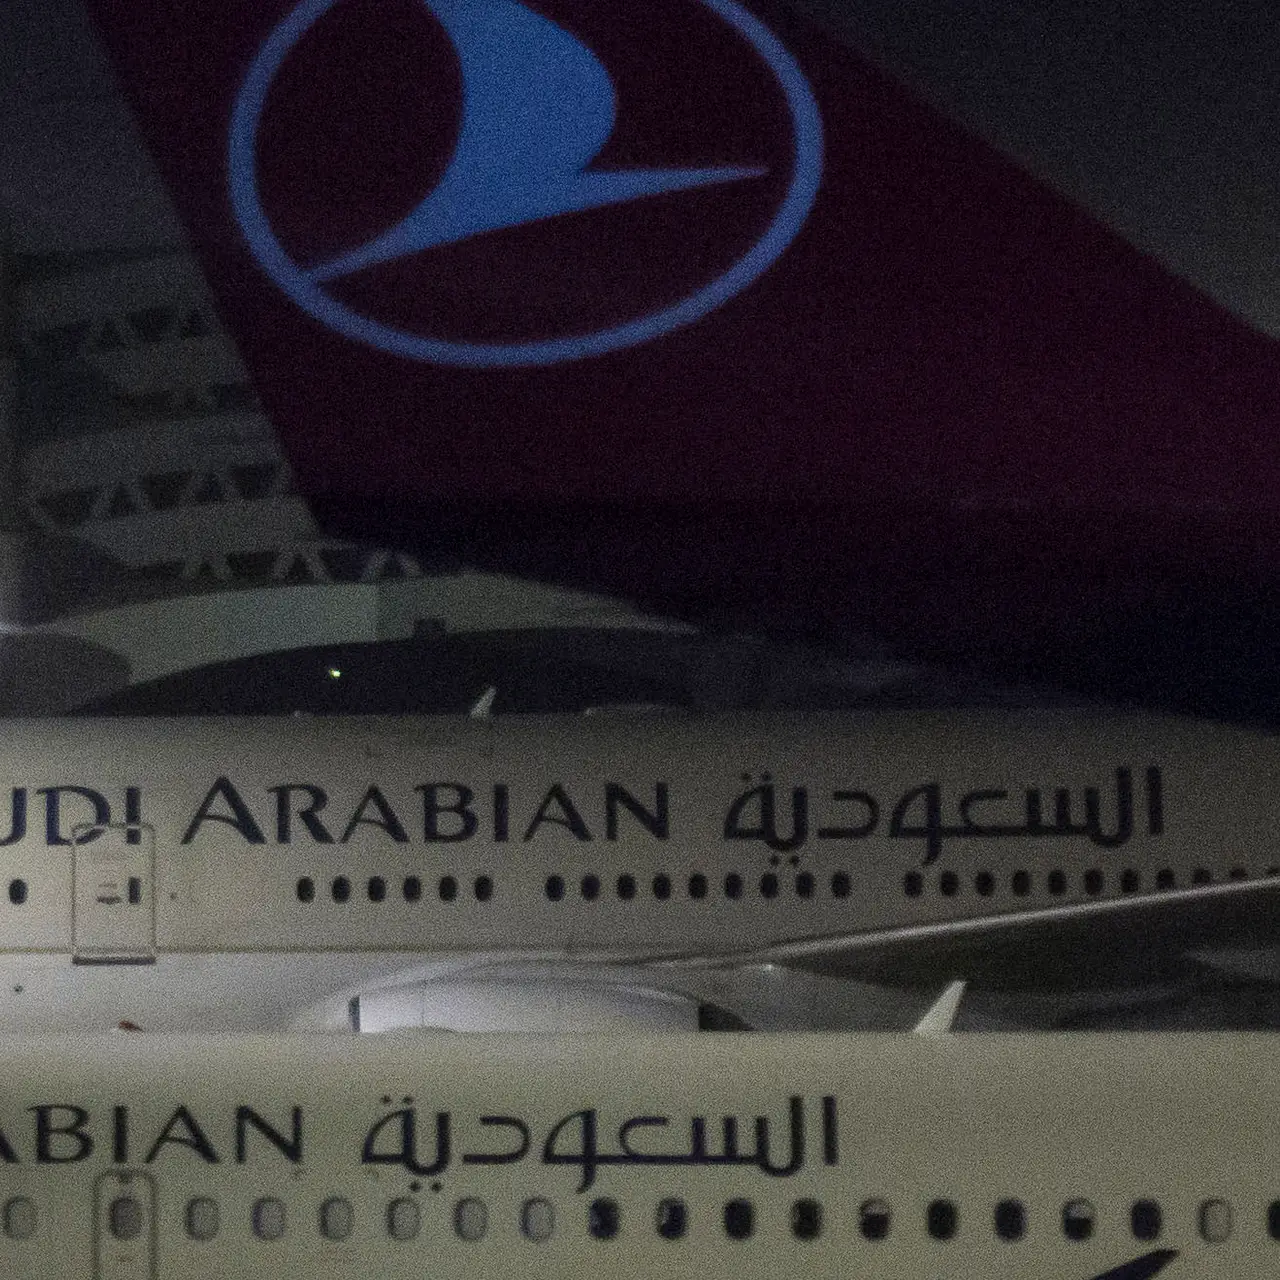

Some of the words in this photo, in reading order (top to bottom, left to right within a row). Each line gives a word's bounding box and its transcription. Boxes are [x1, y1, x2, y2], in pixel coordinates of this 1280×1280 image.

[181, 776, 669, 846] ARABIAN
[723, 766, 1167, 866] السعودية
[360, 1094, 839, 1194] السعودية
